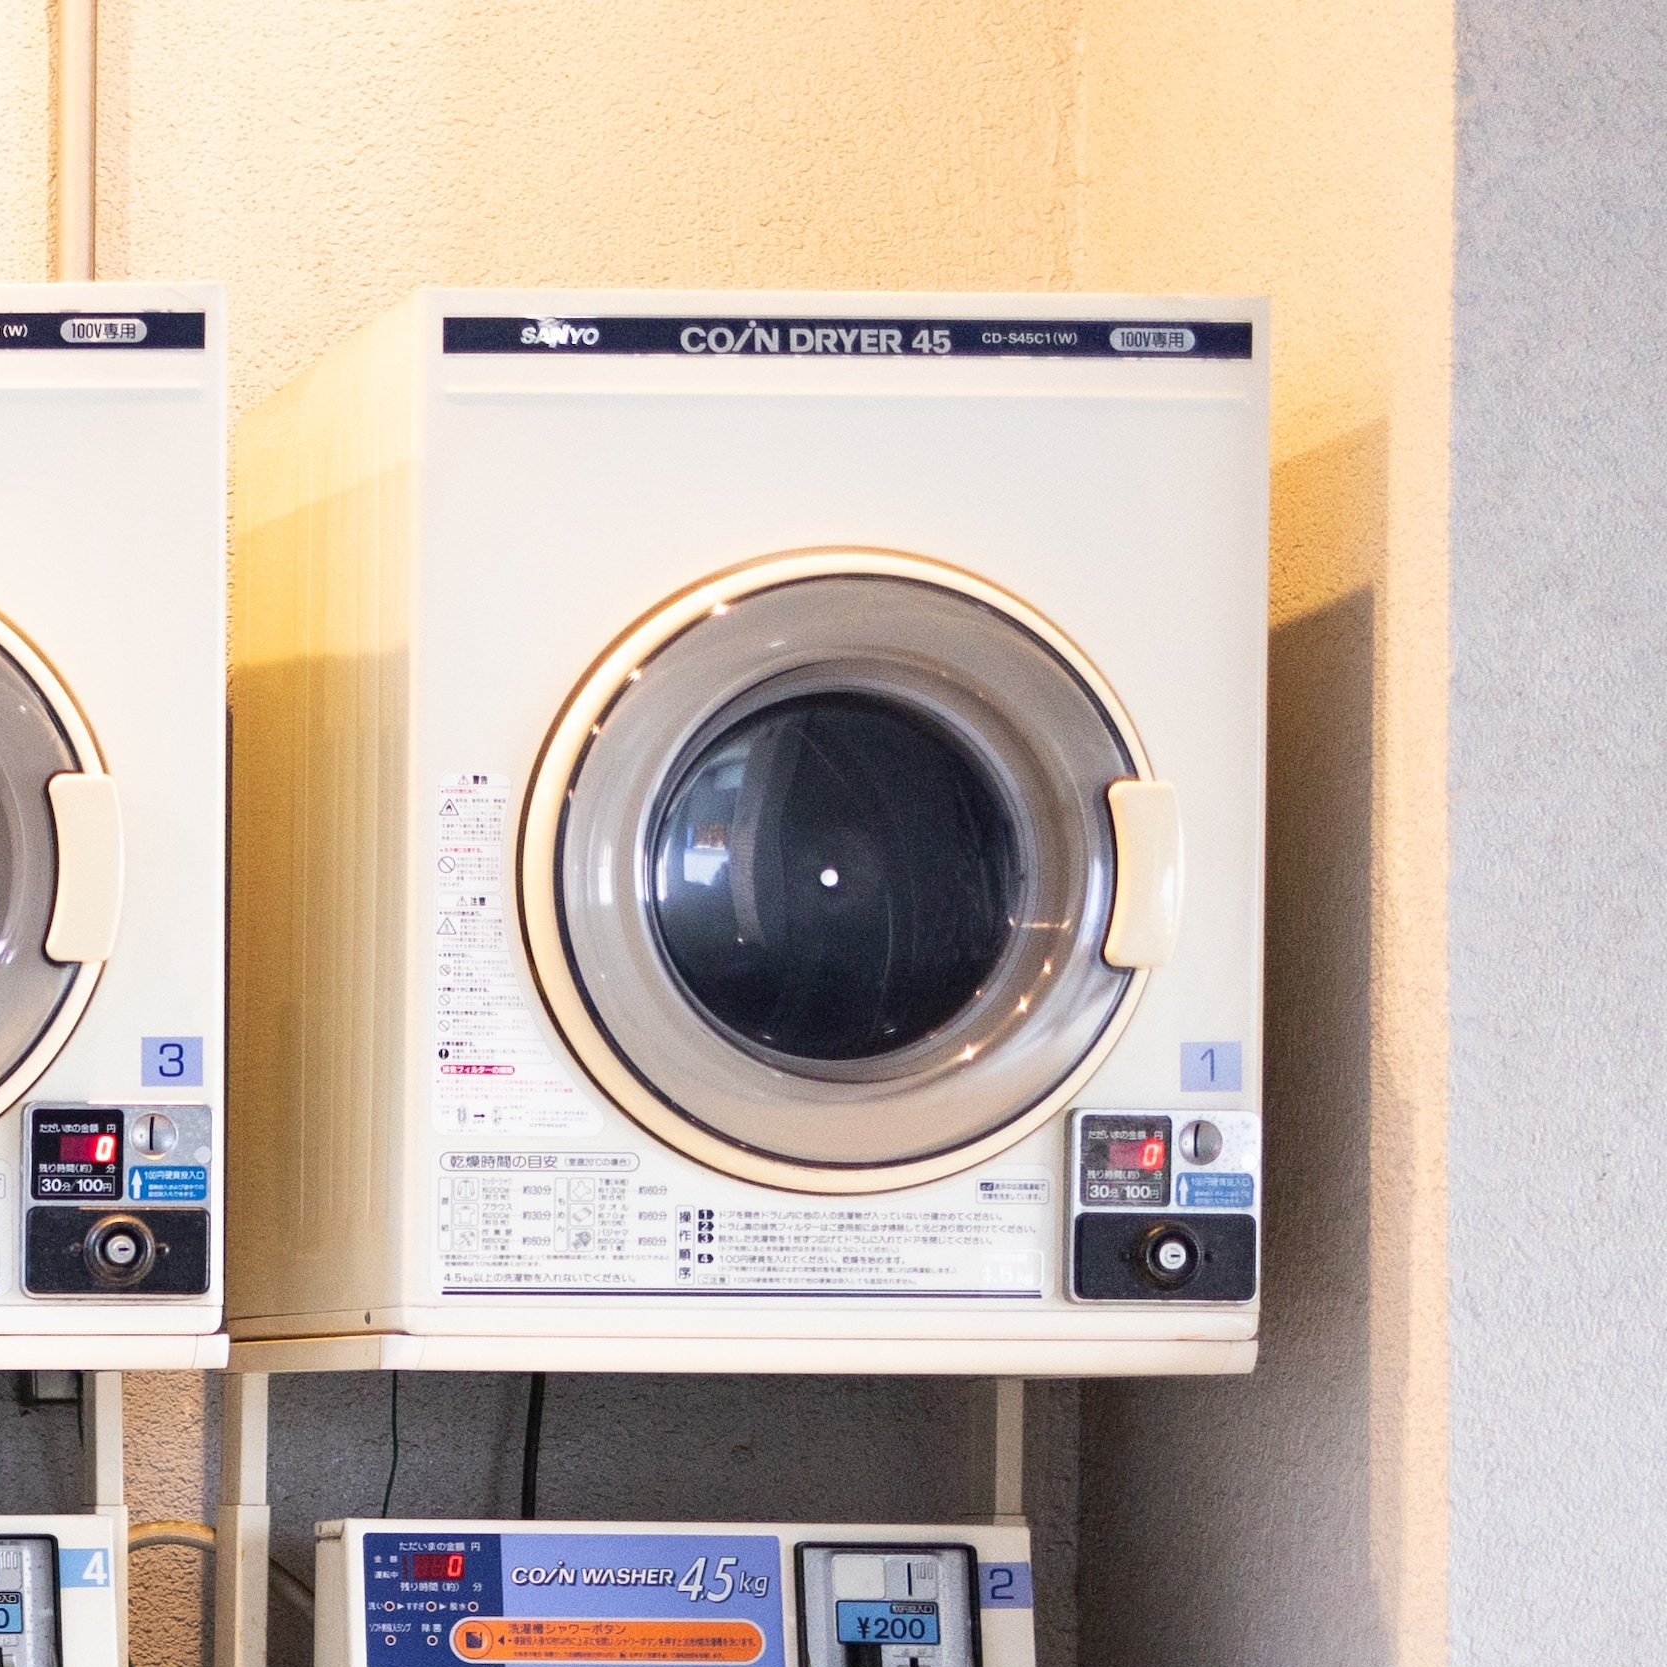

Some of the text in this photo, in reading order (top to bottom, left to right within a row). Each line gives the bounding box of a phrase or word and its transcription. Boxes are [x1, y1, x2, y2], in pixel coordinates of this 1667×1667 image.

[70, 321, 139, 340] 100V専用
[521, 319, 1187, 355] SANYO COIN DRYER 45 CD-S45C1(W) 100V専用
[158, 1043, 184, 1077] 3
[1200, 1048, 1215, 1083] 1
[39, 1123, 115, 1133] ただいまの金額 円
[95, 1136, 114, 1161] 0
[1142, 1143, 1159, 1167] 0
[106, 1164, 115, 1173] 分
[450, 1155, 558, 1168] 乾燥時間の目安
[399, 1542, 481, 1551] ただいまの金額 円
[82, 1551, 107, 1585] 4
[447, 1555, 463, 1578] 0
[473, 1583, 482, 1592] 分
[511, 1557, 769, 1602] COIN WASHER 4.5 kg
[989, 1568, 1014, 1600] 2
[857, 1617, 926, 1639] ¥200
